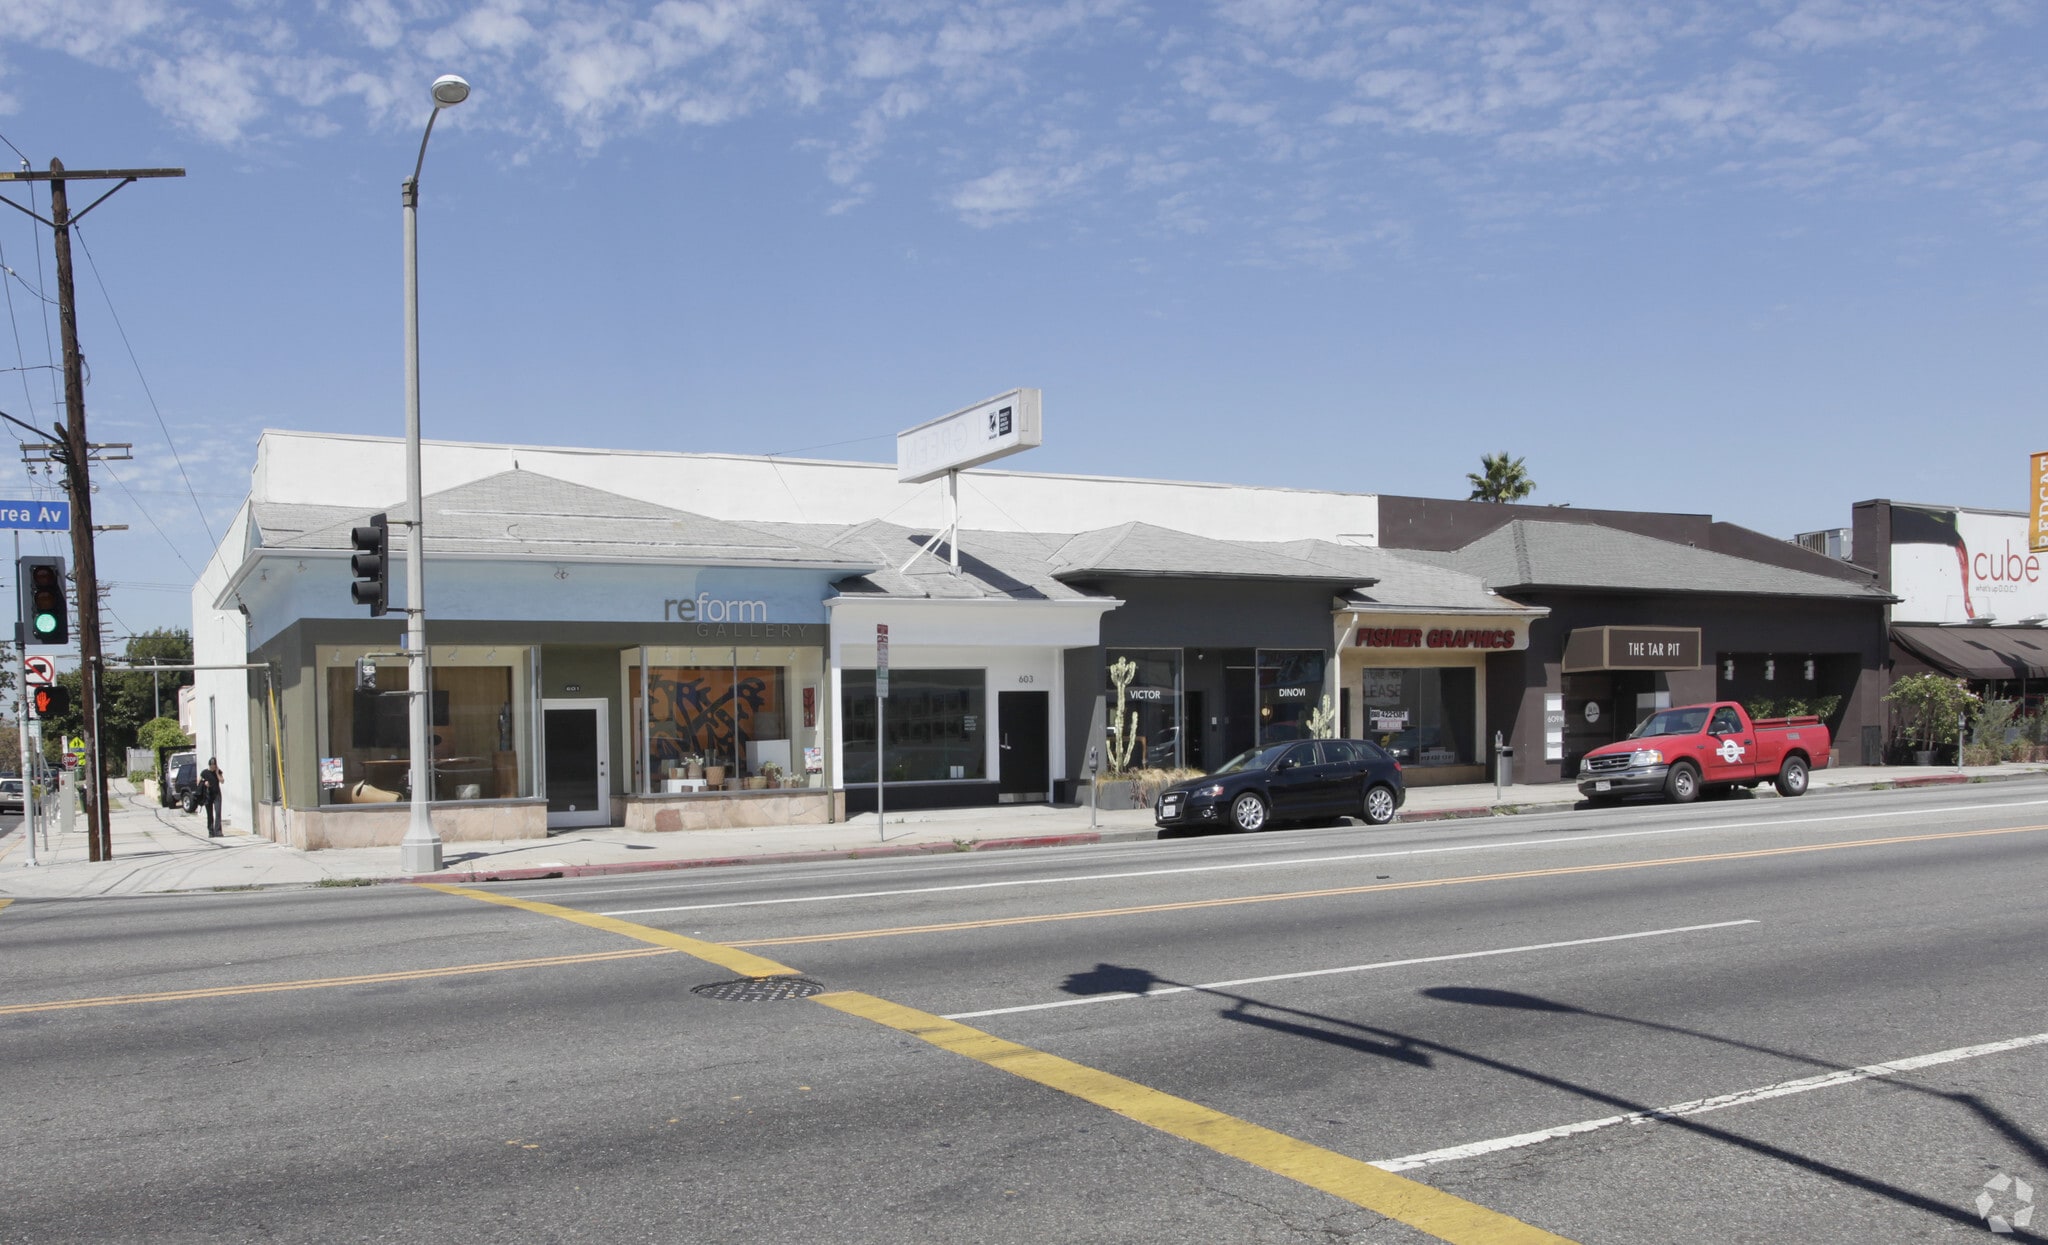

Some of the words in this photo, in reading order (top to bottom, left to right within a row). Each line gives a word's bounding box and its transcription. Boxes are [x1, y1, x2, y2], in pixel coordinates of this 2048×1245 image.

[0, 509, 30, 522] rea
[38, 506, 61, 522] Av
[1974, 539, 2040, 582] cube
[664, 592, 767, 622] reform
[696, 624, 807, 638] GALLERY
[1355, 628, 1422, 648] FISHER
[1427, 629, 1515, 648] GRAPHICS
[1628, 642, 1644, 656] THE
[1647, 642, 1664, 656] TAR
[1667, 643, 1680, 656] PIT
[1018, 675, 1034, 683] 603
[1130, 690, 1161, 699] VICTOR
[1279, 688, 1306, 697] DINOVI
[1363, 684, 1401, 698] LEASE
